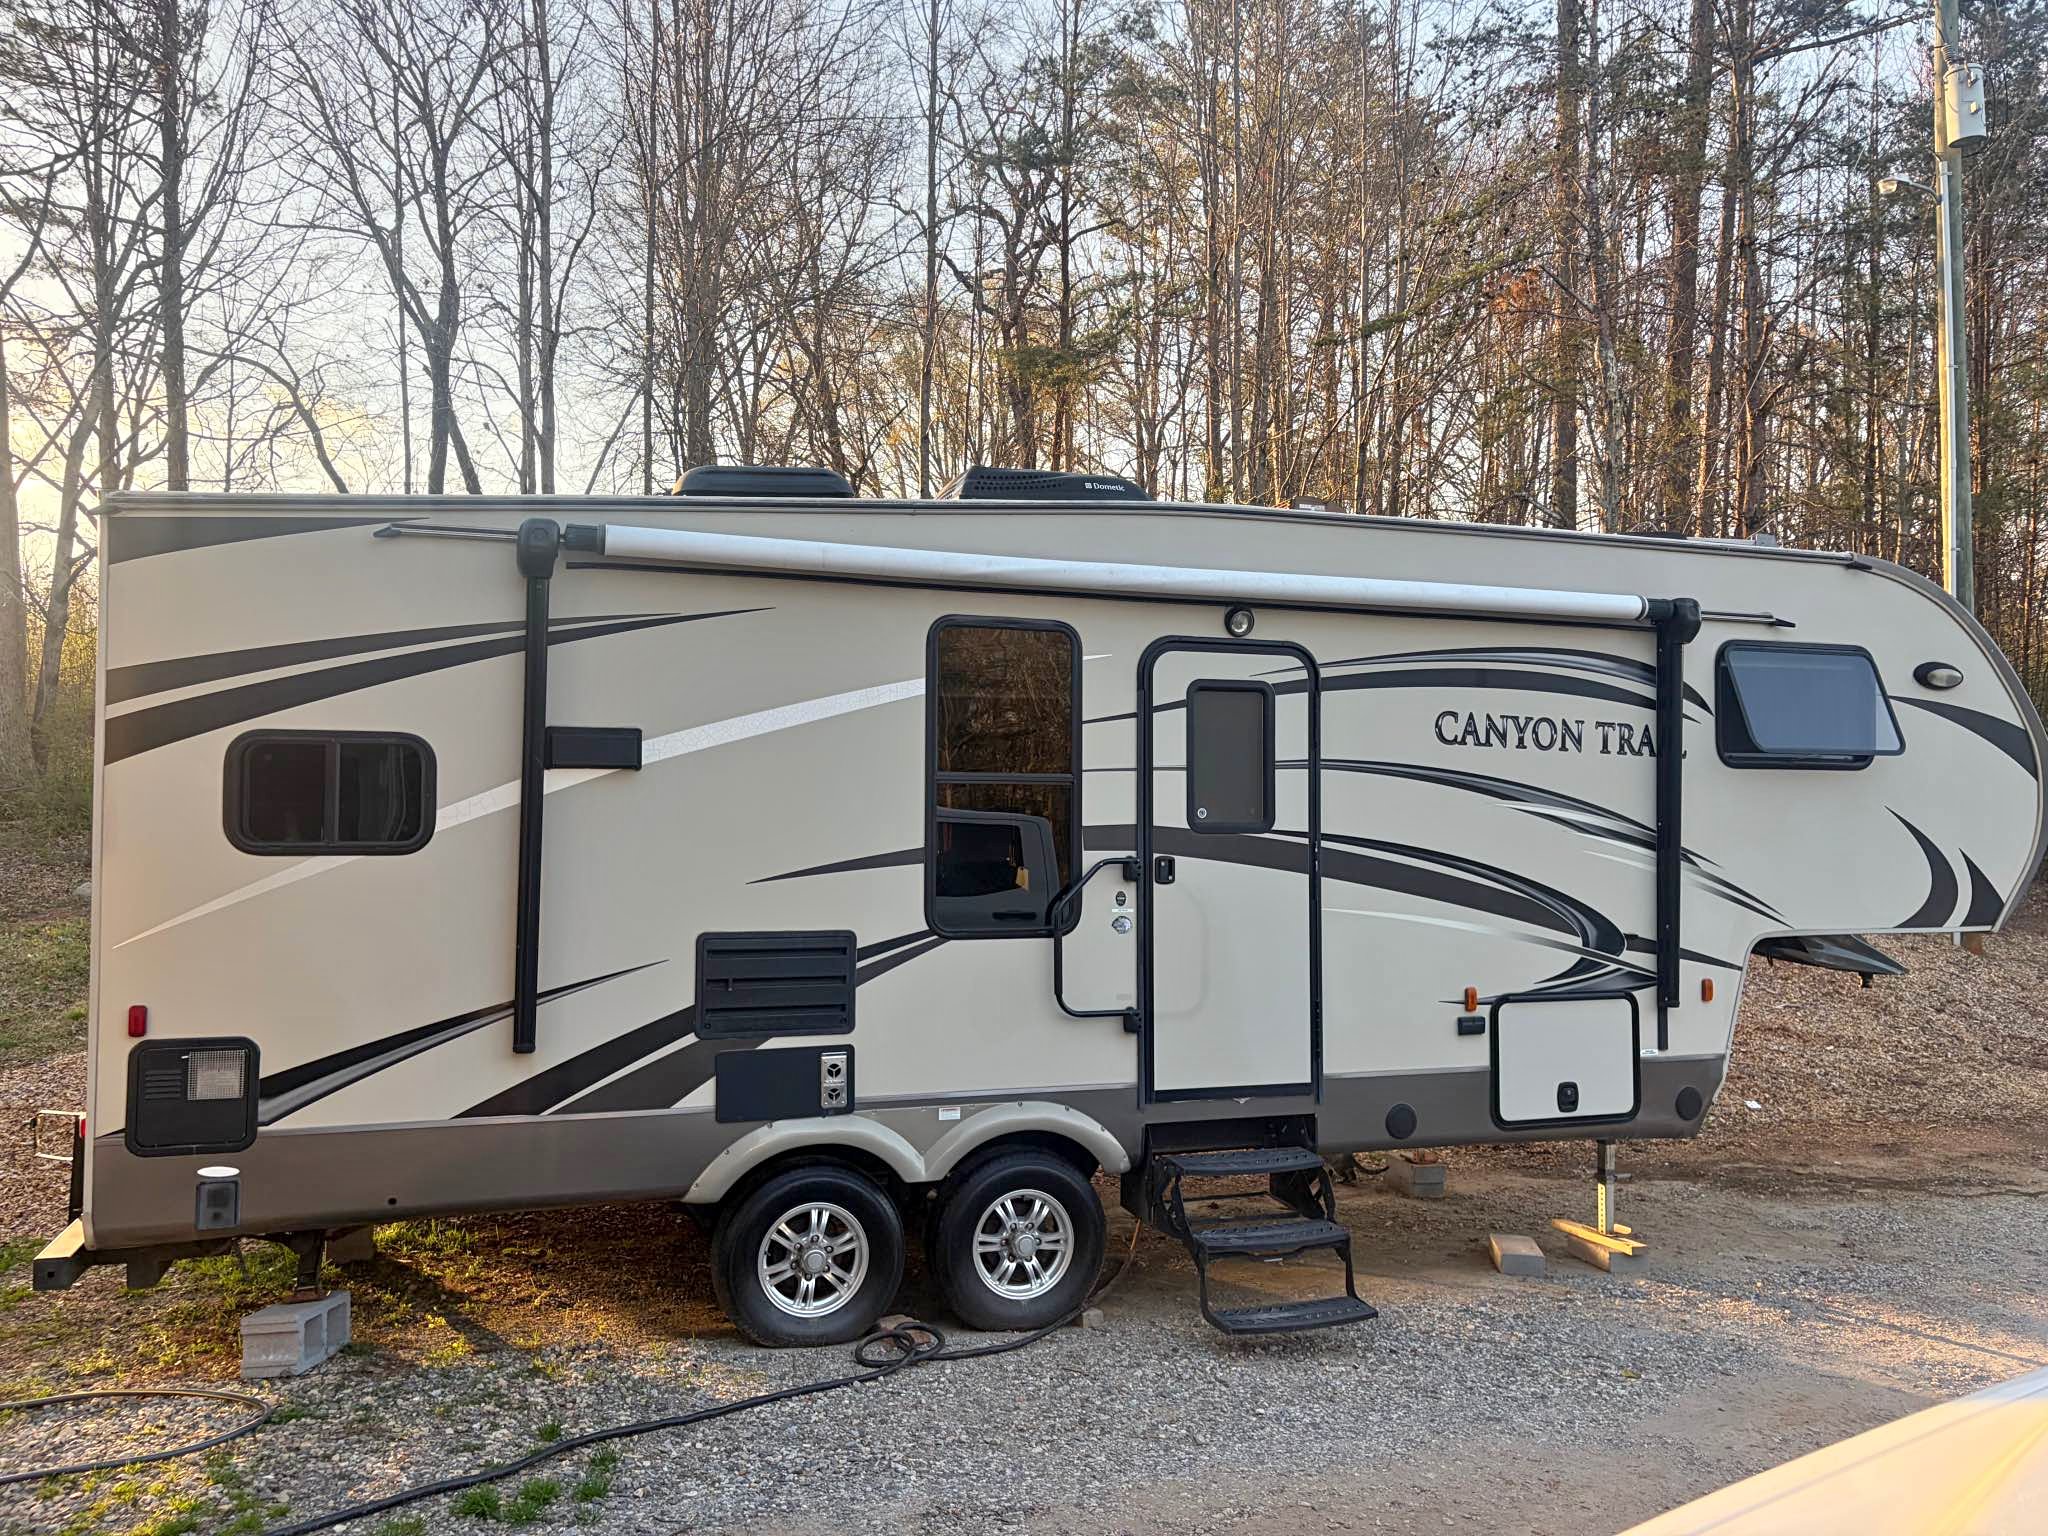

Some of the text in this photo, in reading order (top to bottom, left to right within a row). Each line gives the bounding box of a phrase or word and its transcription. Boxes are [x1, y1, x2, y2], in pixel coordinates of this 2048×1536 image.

[1093, 482, 1125, 492] Dometic
[1434, 710, 1687, 759] CANYON TRA
